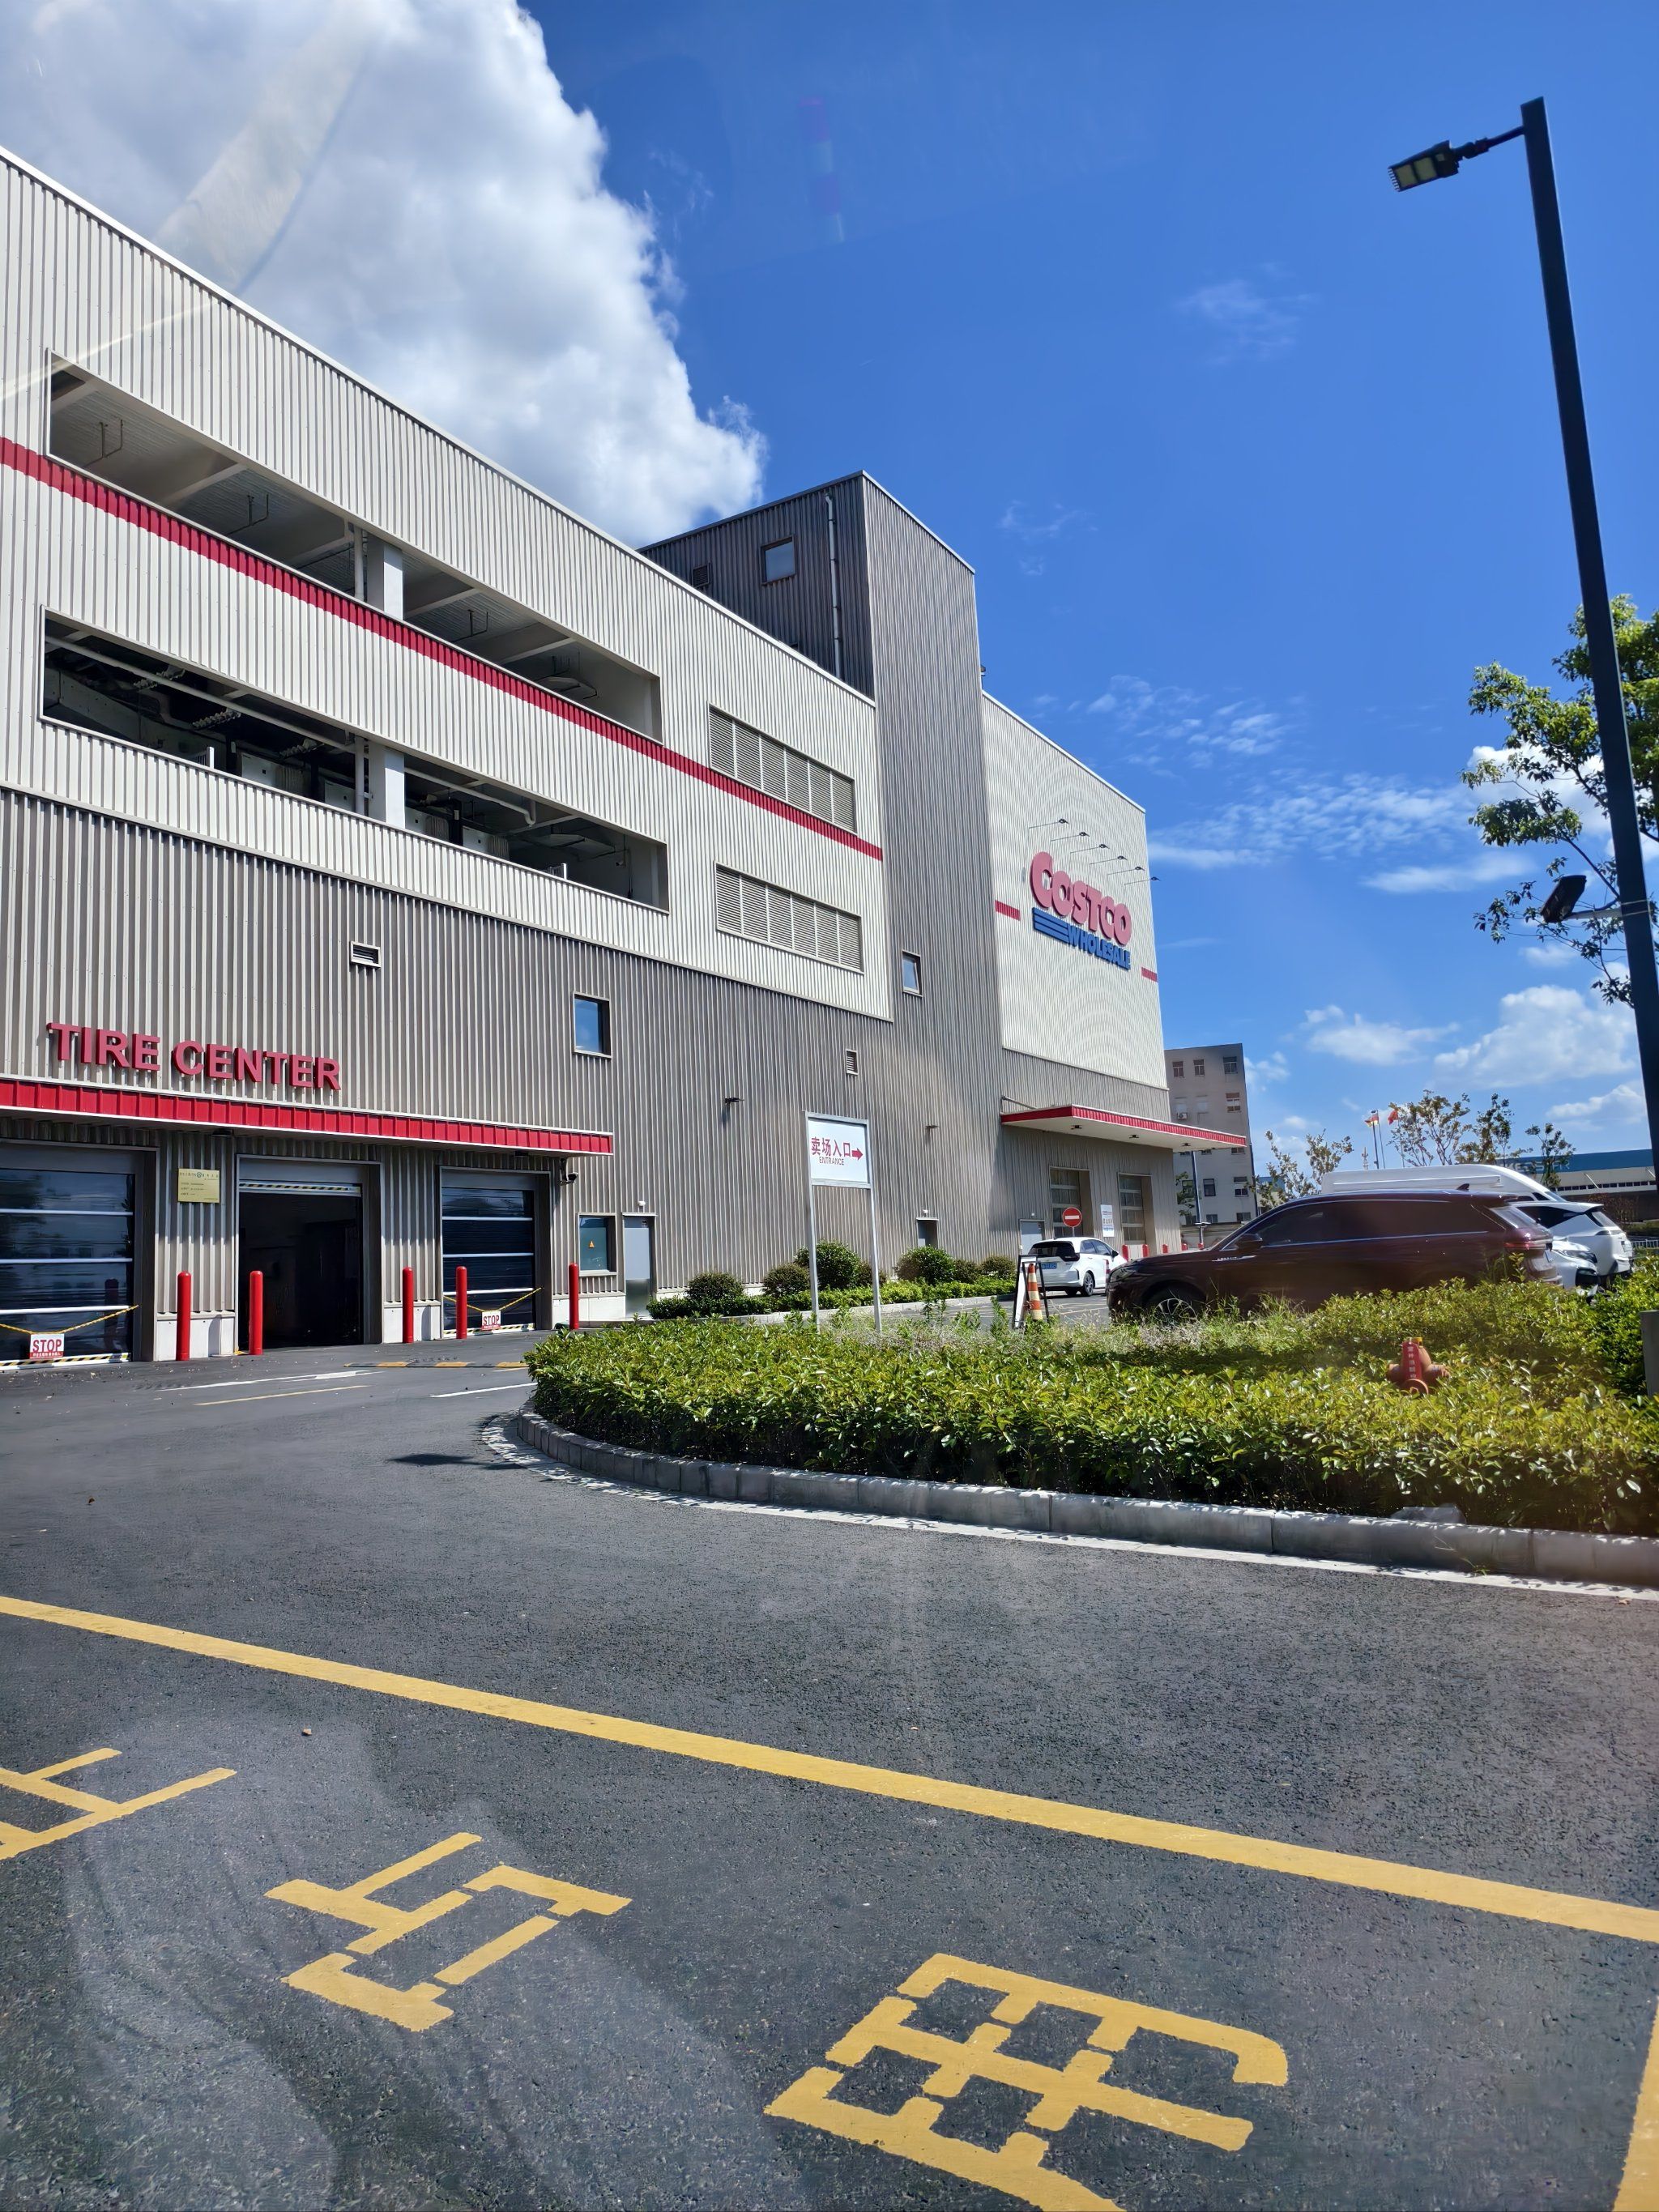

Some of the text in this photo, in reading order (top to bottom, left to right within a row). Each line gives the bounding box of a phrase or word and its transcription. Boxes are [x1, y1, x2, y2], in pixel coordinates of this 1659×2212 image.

[1030, 851, 1132, 945] COSTCO
[1067, 923, 1131, 970] WHOLESALE
[47, 1022, 341, 1091] TIRE CENTER
[811, 1136, 851, 1157] 卖场入口
[819, 1156, 844, 1166] ENTRANCE
[483, 1315, 499, 1325] STOP
[32, 1339, 62, 1353] STOP
